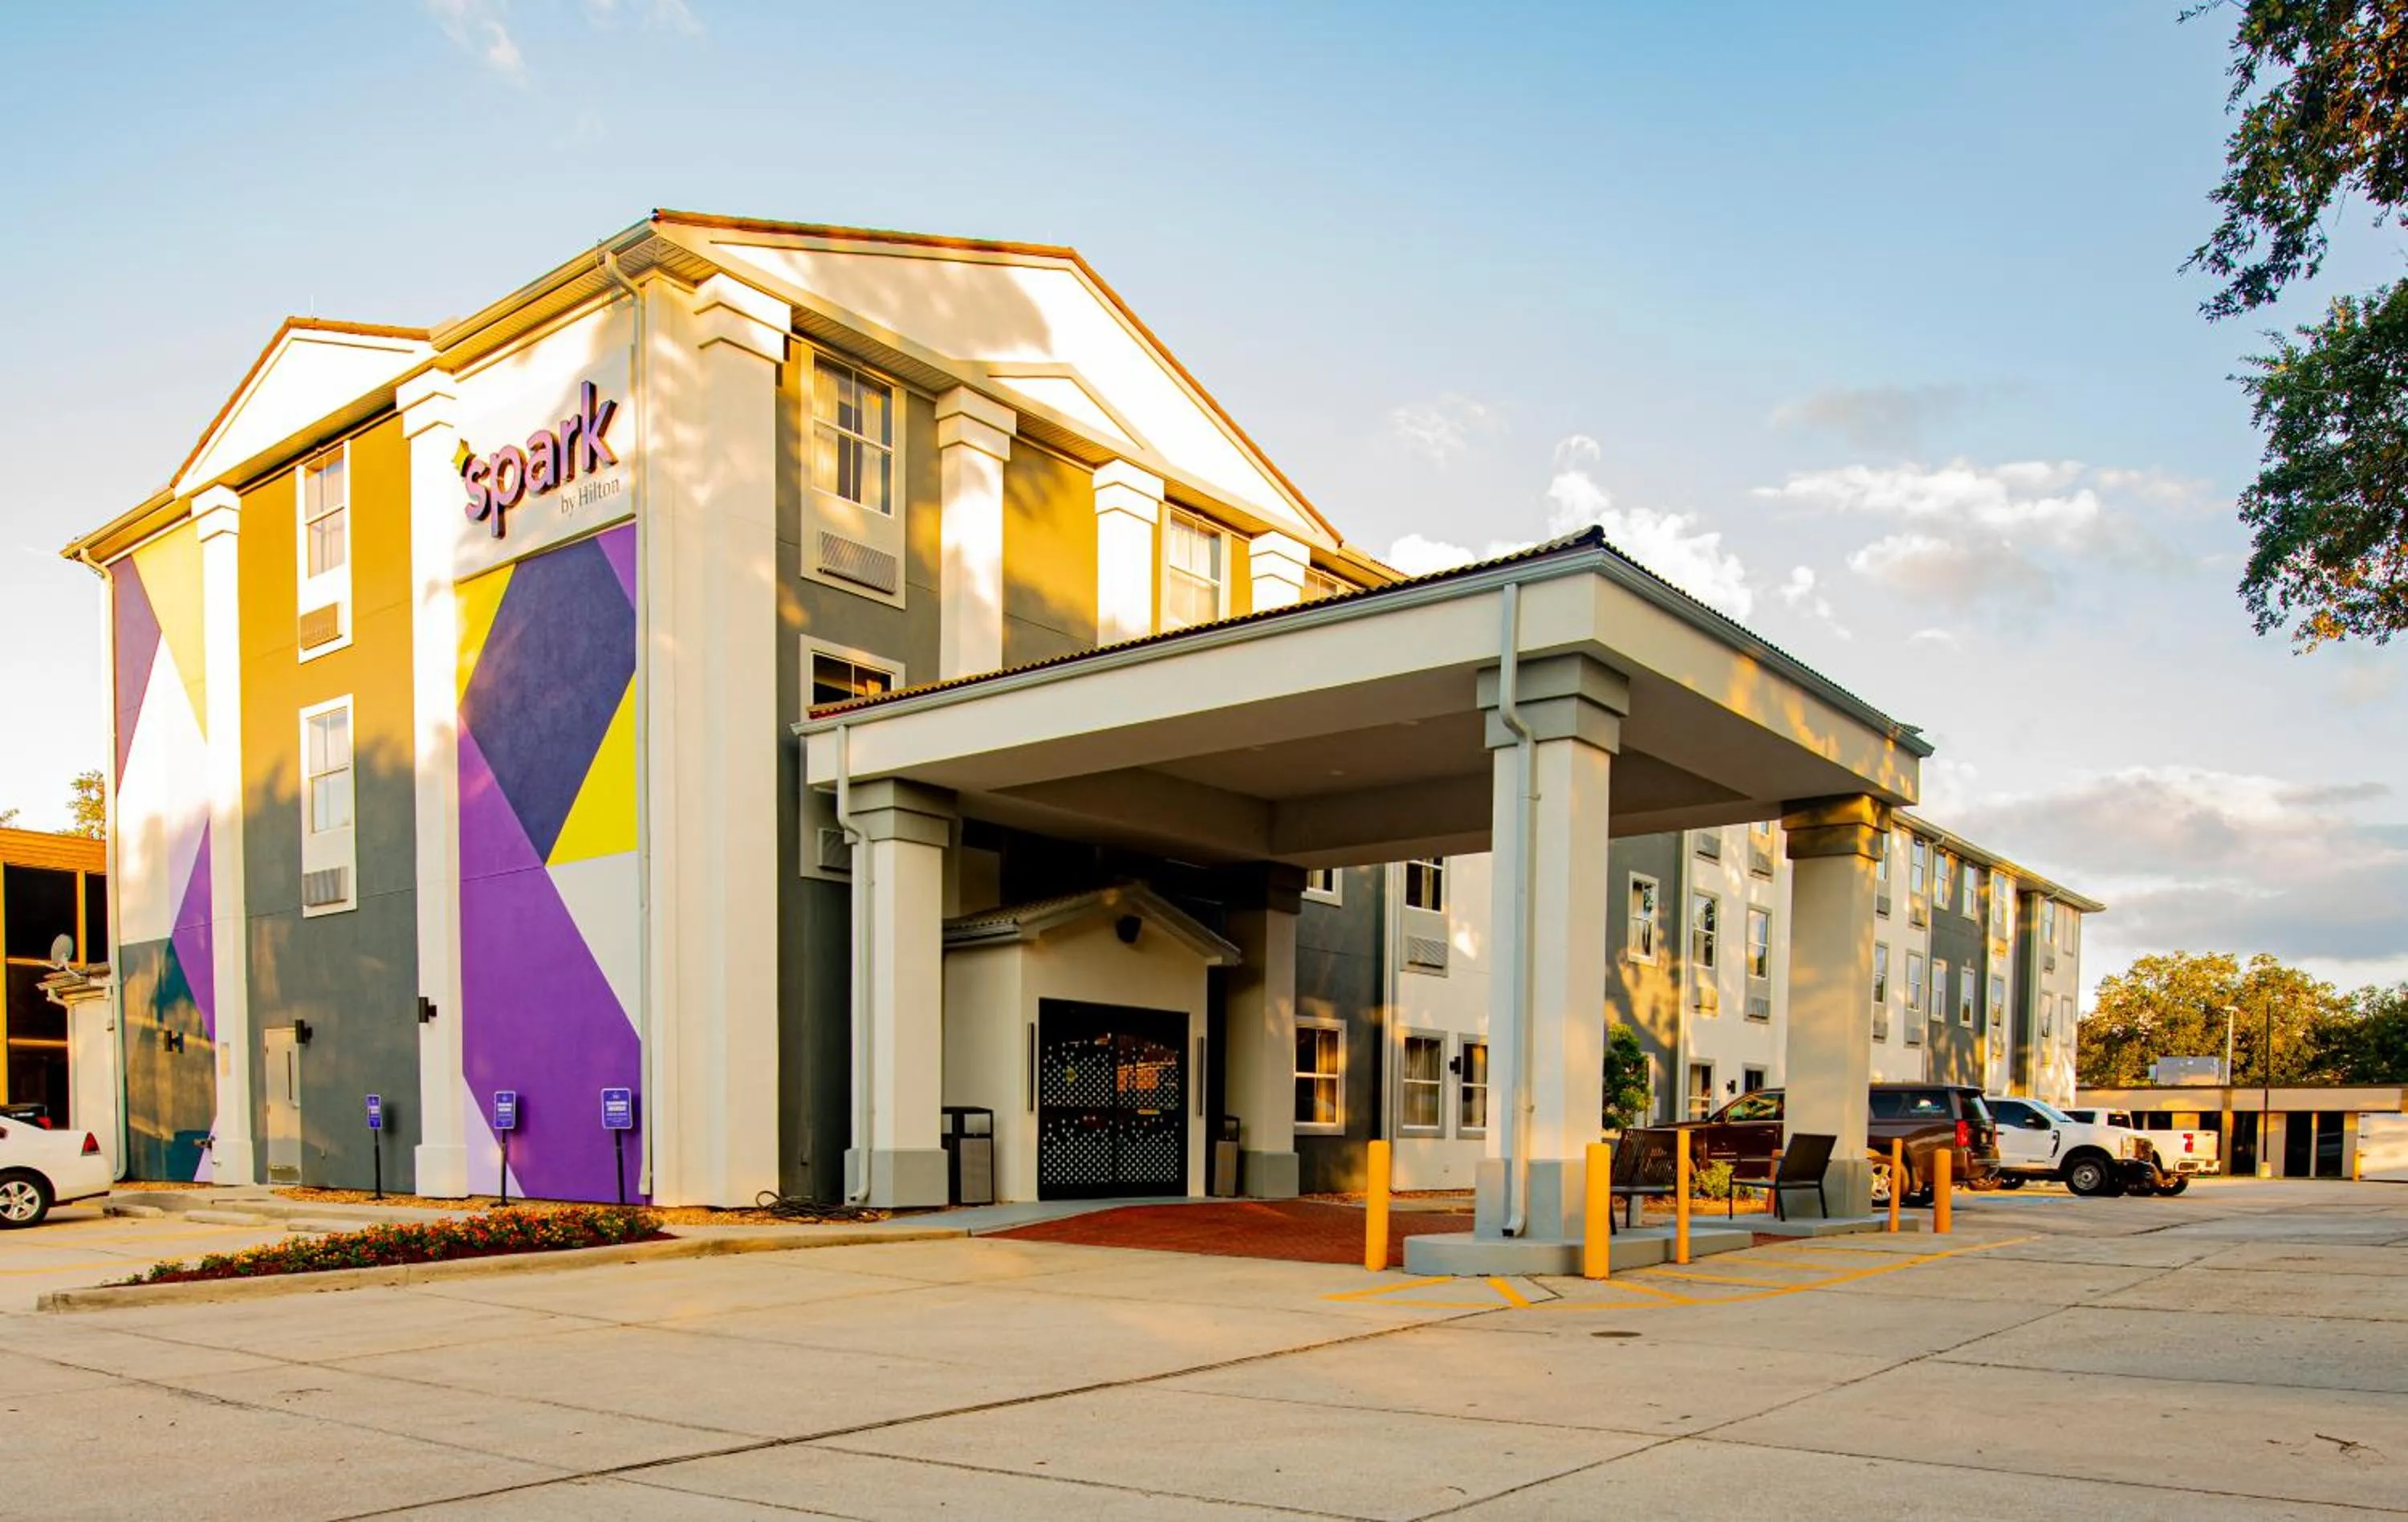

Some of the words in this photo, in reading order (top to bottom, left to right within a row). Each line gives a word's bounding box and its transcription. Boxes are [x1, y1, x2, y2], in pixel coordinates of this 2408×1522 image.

[463, 380, 618, 539] spark
[560, 494, 576, 518] by
[579, 479, 619, 506] Hilton
